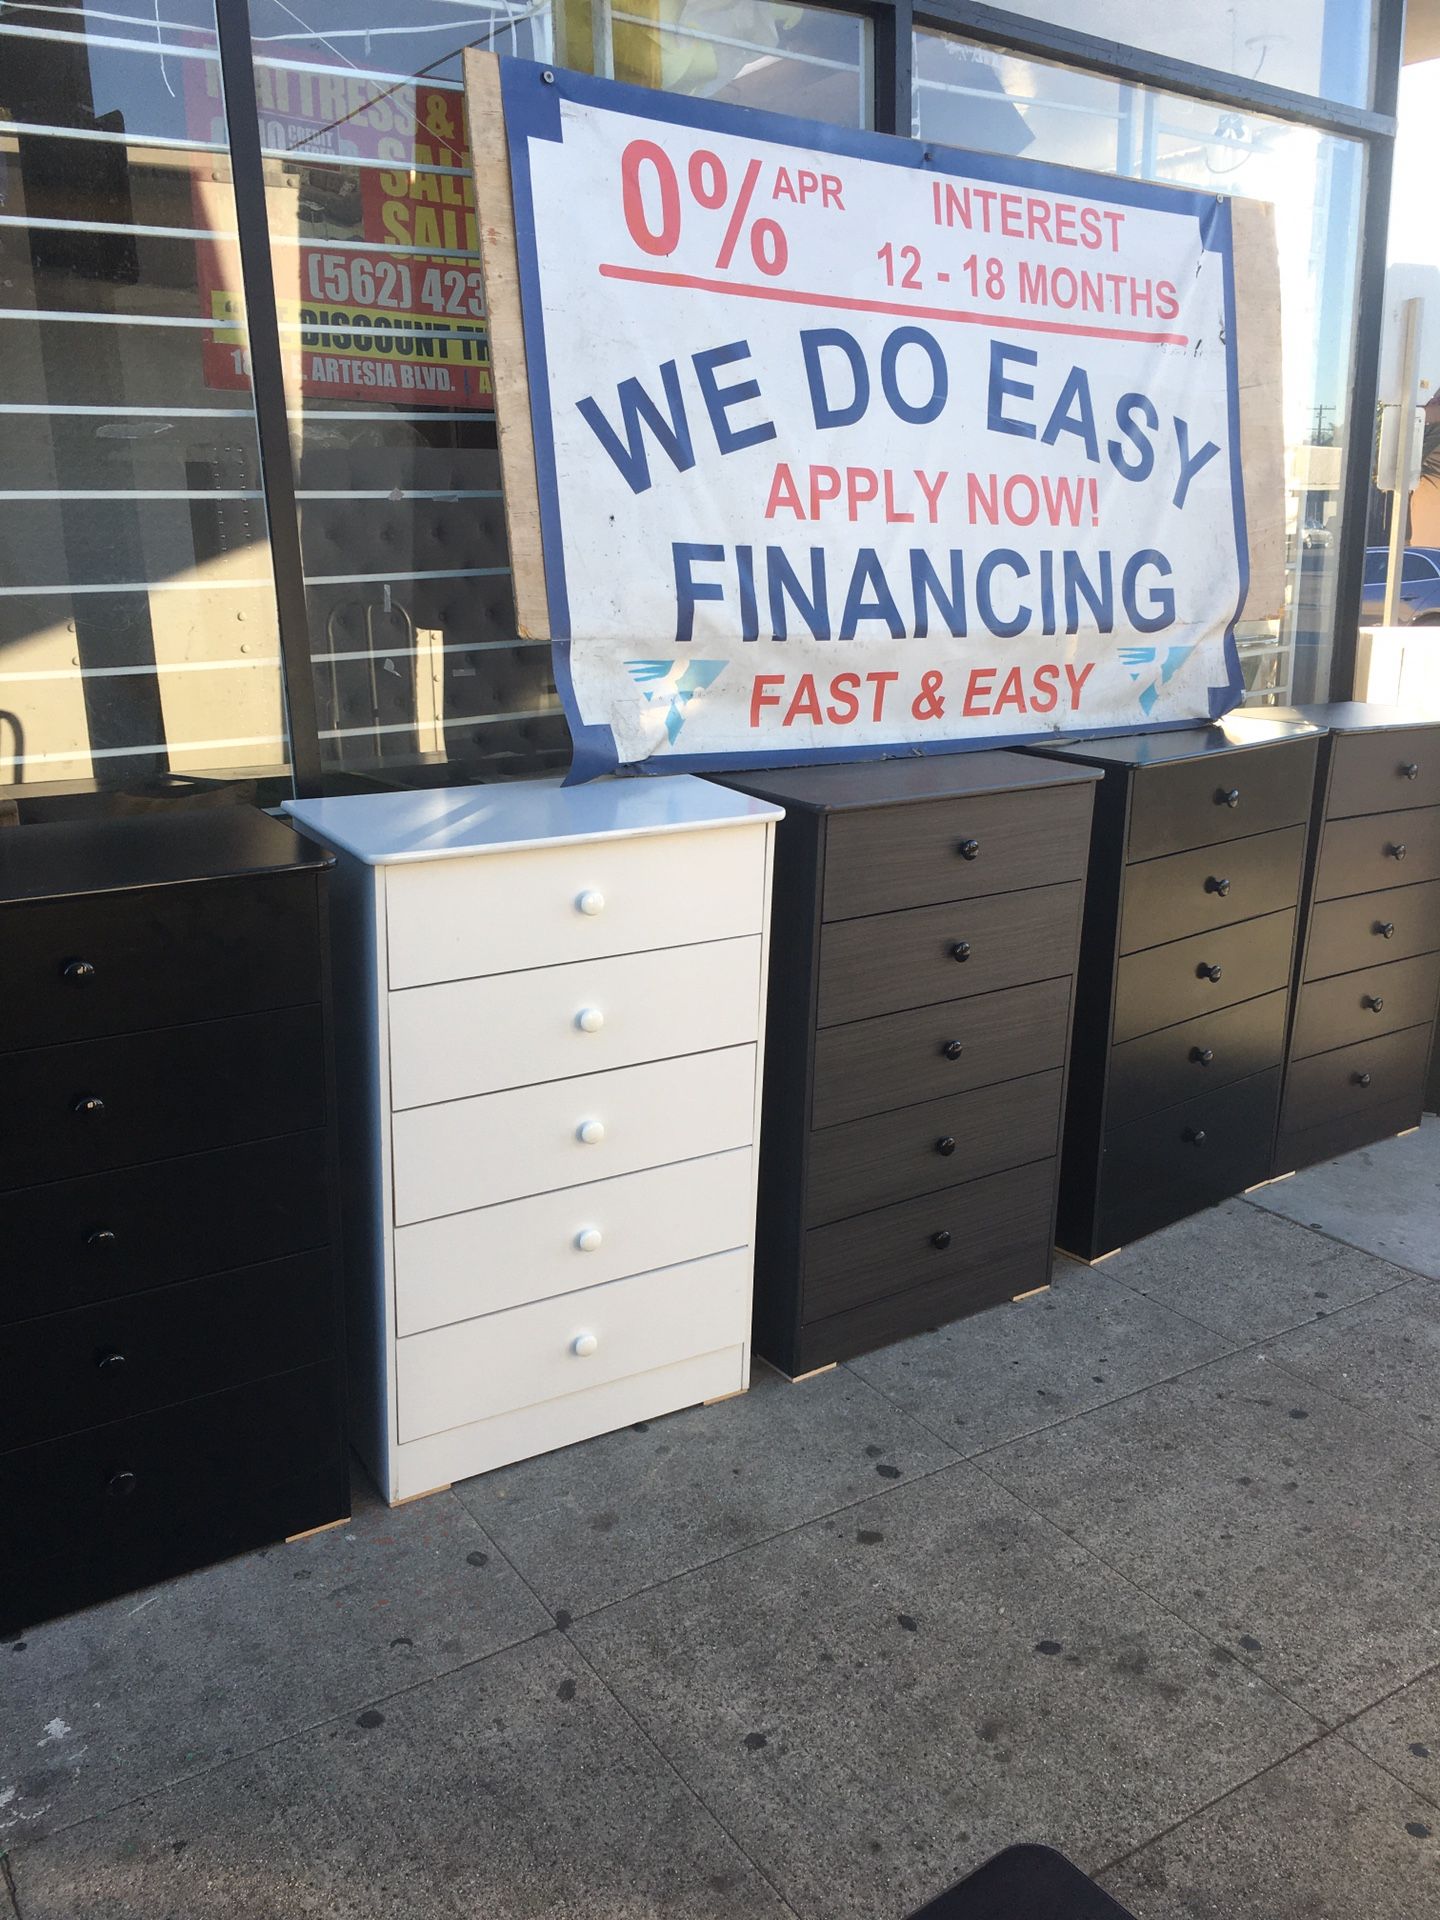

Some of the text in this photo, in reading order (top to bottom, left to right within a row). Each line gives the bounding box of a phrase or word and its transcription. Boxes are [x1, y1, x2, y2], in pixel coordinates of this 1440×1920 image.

[621, 139, 846, 276] 0% APR
[932, 181, 1125, 252] INTEREST
[308, 253, 412, 310] (562)
[877, 242, 923, 290] 12
[963, 254, 1006, 300] 18
[1018, 261, 1180, 320] MONTHS
[299, 308, 449, 358] DISCOUNT
[312, 356, 397, 388] ARTESIA
[401, 360, 456, 392] BLVD.
[575, 325, 1221, 510] WE DO EASY
[764, 462, 1100, 528] APPLY NOW!
[671, 541, 1177, 642] FINANCING
[750, 662, 1096, 728] FAST & EASY
